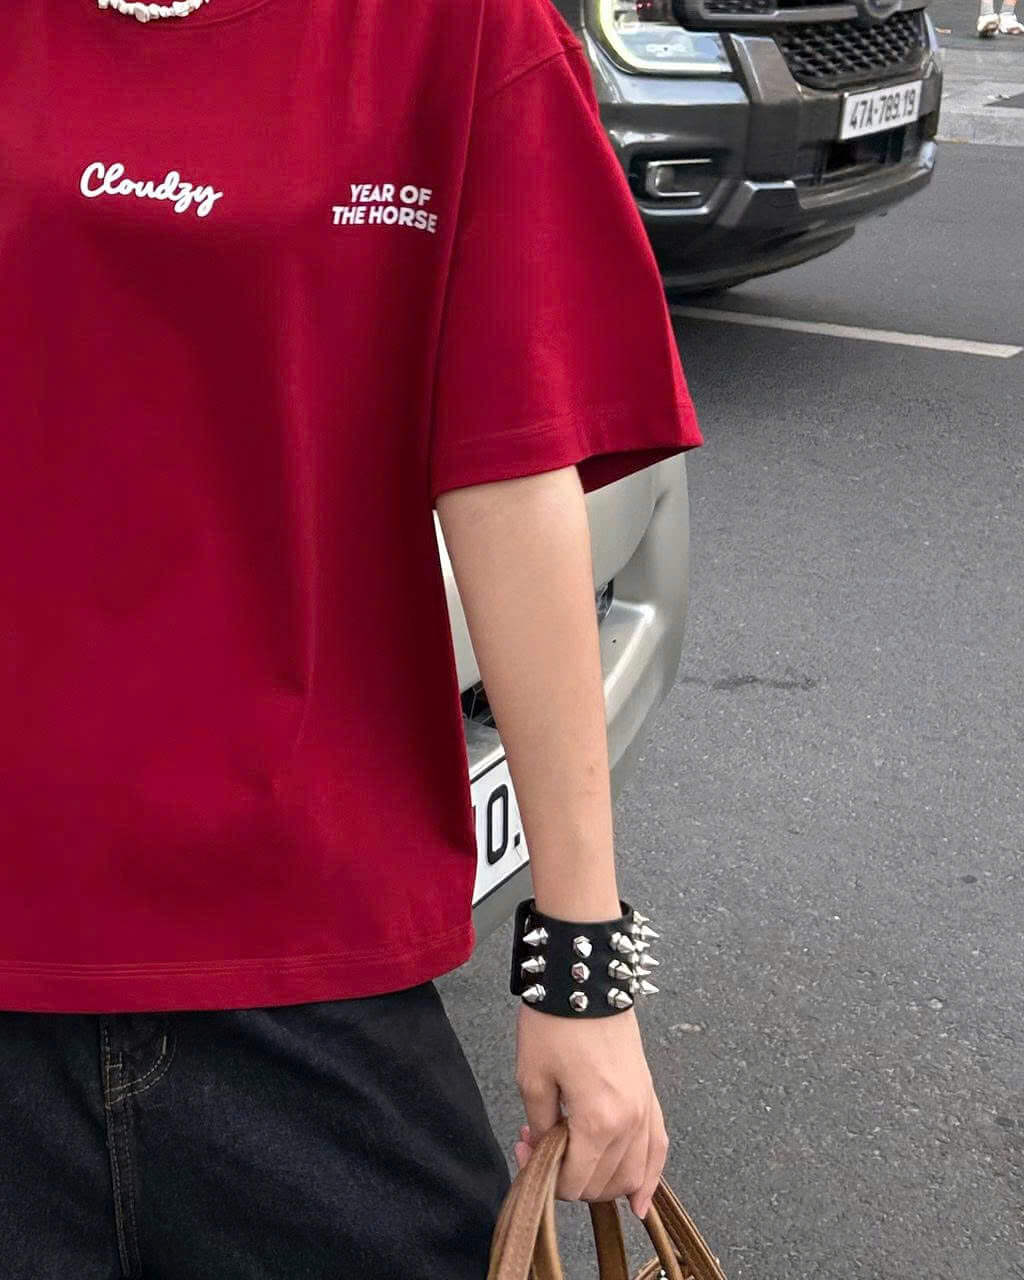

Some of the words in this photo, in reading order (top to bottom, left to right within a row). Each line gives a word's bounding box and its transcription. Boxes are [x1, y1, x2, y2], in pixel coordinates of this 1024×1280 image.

[80, 161, 224, 217] Cloudzy
[350, 183, 395, 203] YEAR
[399, 184, 433, 206] OF
[332, 205, 367, 225] THE
[368, 205, 438, 233] HORSE
